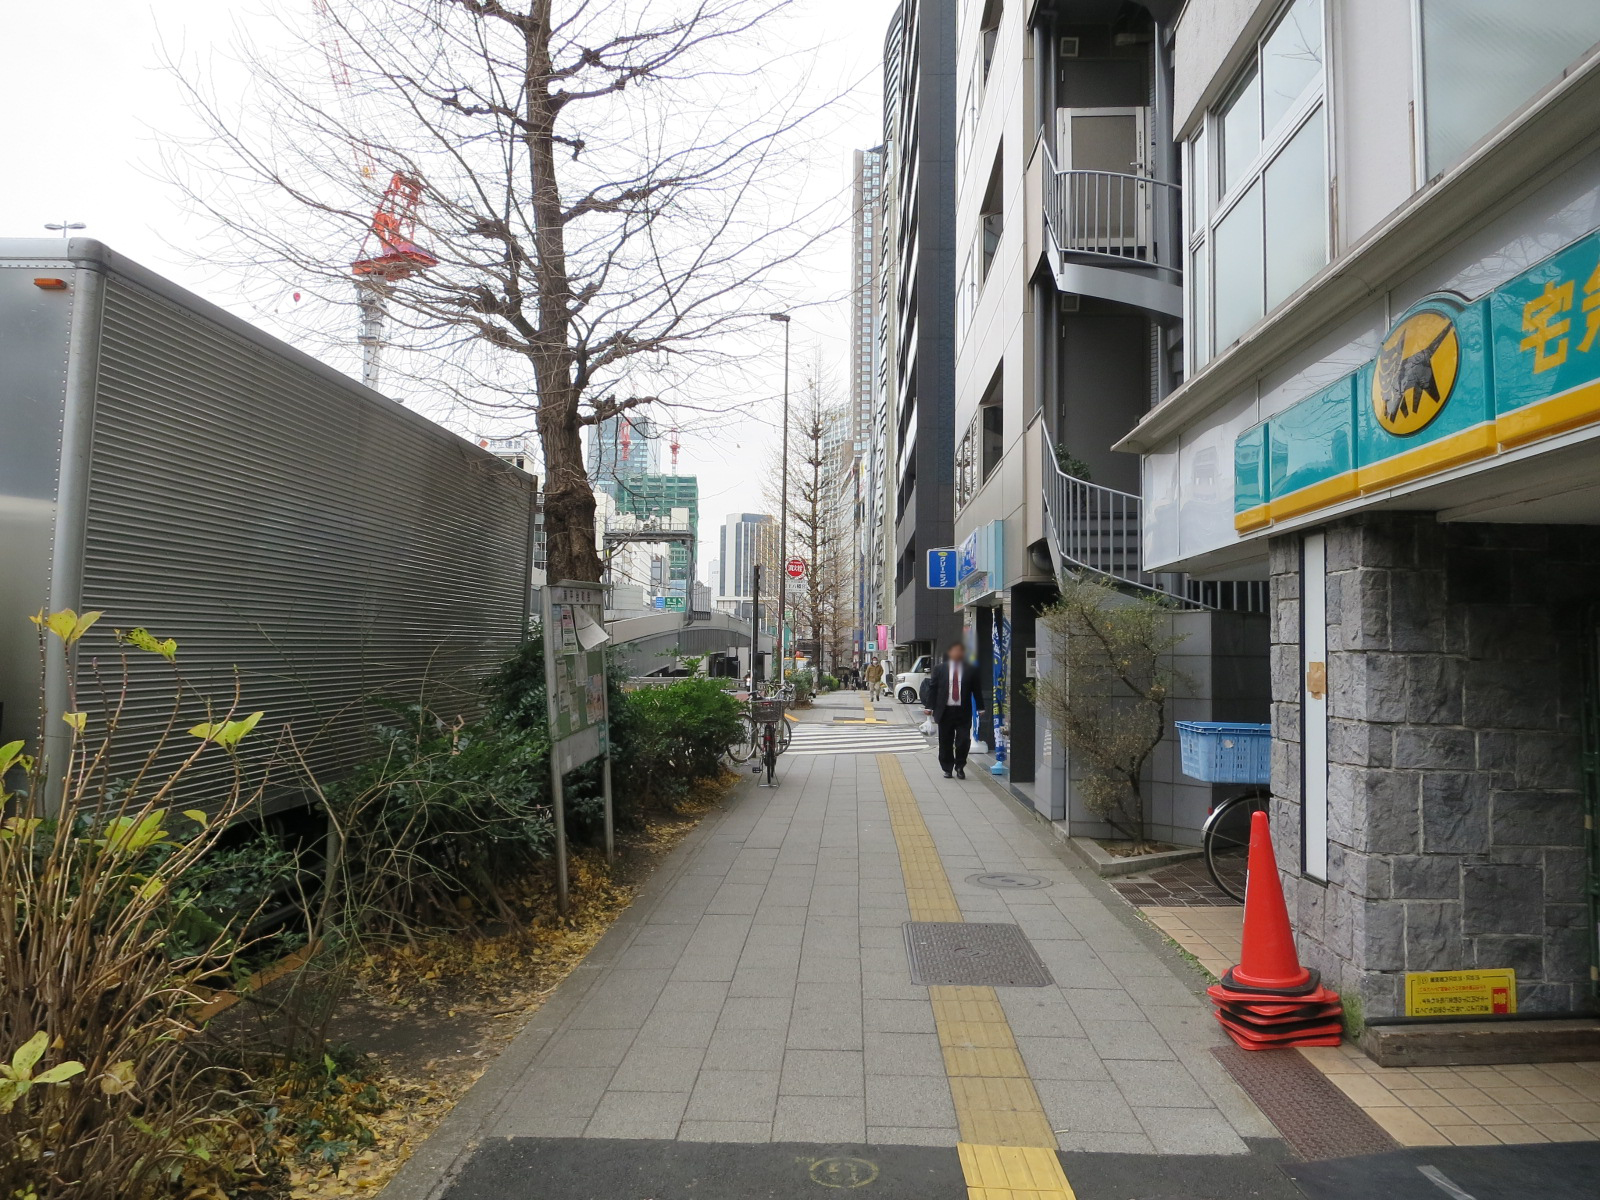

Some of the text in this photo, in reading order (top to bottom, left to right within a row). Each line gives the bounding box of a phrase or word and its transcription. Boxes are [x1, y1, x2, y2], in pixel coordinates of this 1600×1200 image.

[940, 556, 948, 586] クリーニング
